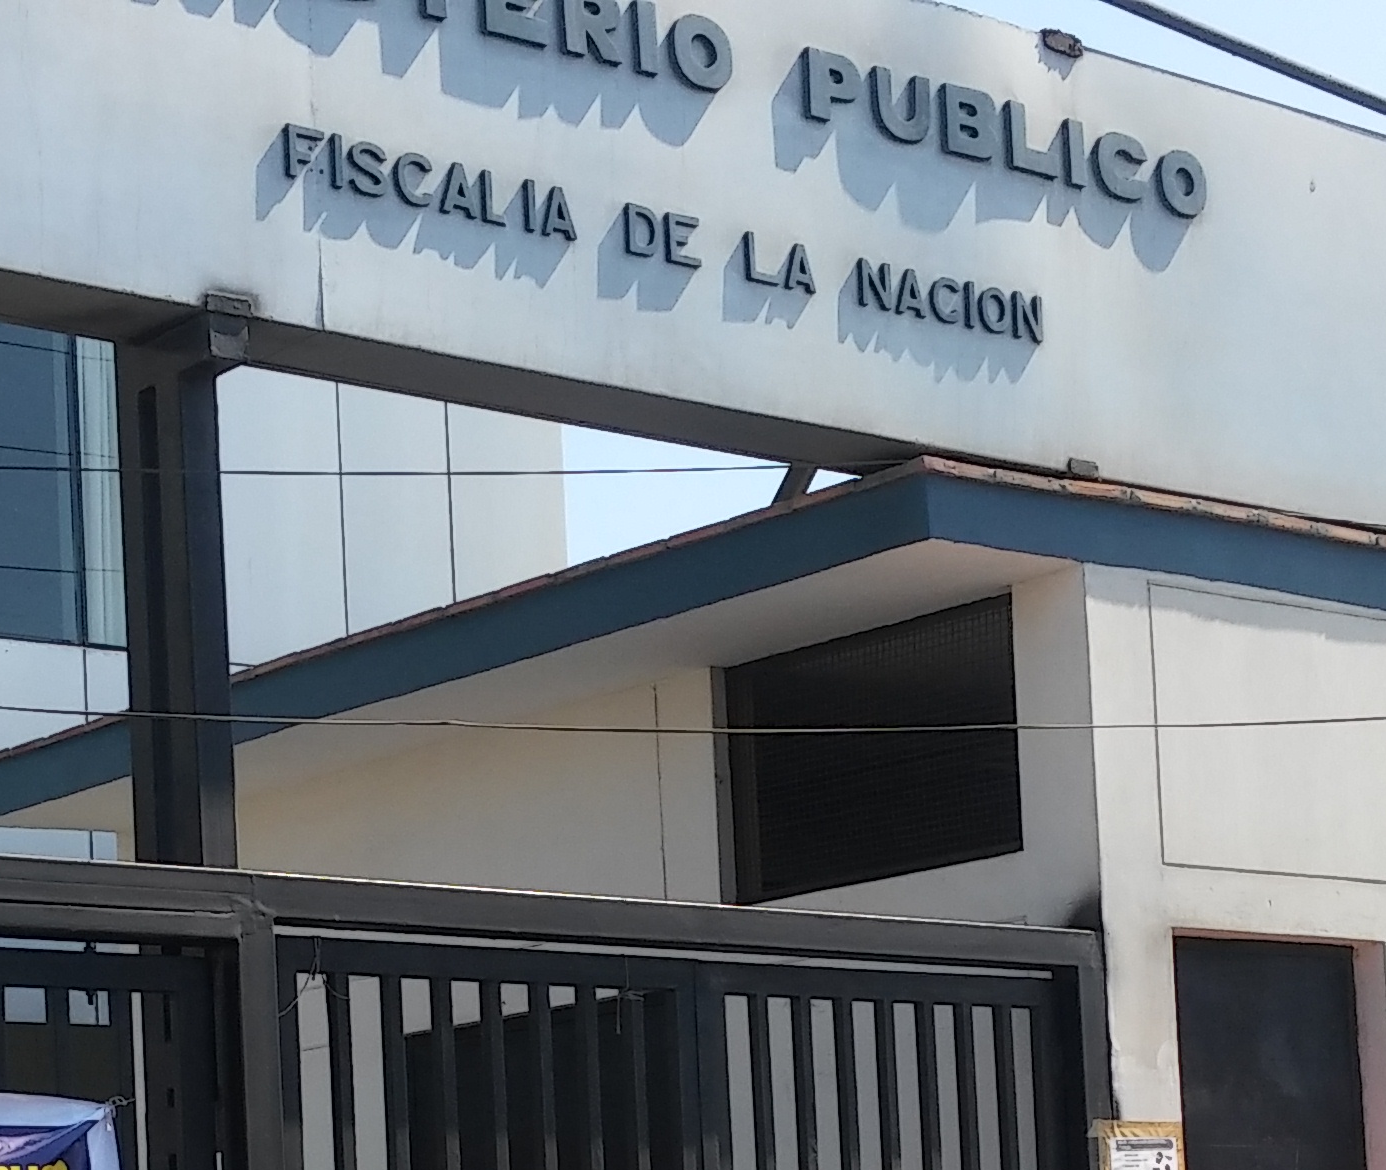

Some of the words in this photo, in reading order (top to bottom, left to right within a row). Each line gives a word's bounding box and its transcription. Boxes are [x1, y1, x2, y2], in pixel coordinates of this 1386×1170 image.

[801, 46, 1207, 219] PUBLICO
[283, 123, 577, 241] FISCALIA
[625, 202, 701, 267] DE
[741, 231, 816, 295] LA
[857, 257, 1044, 344] NACION
